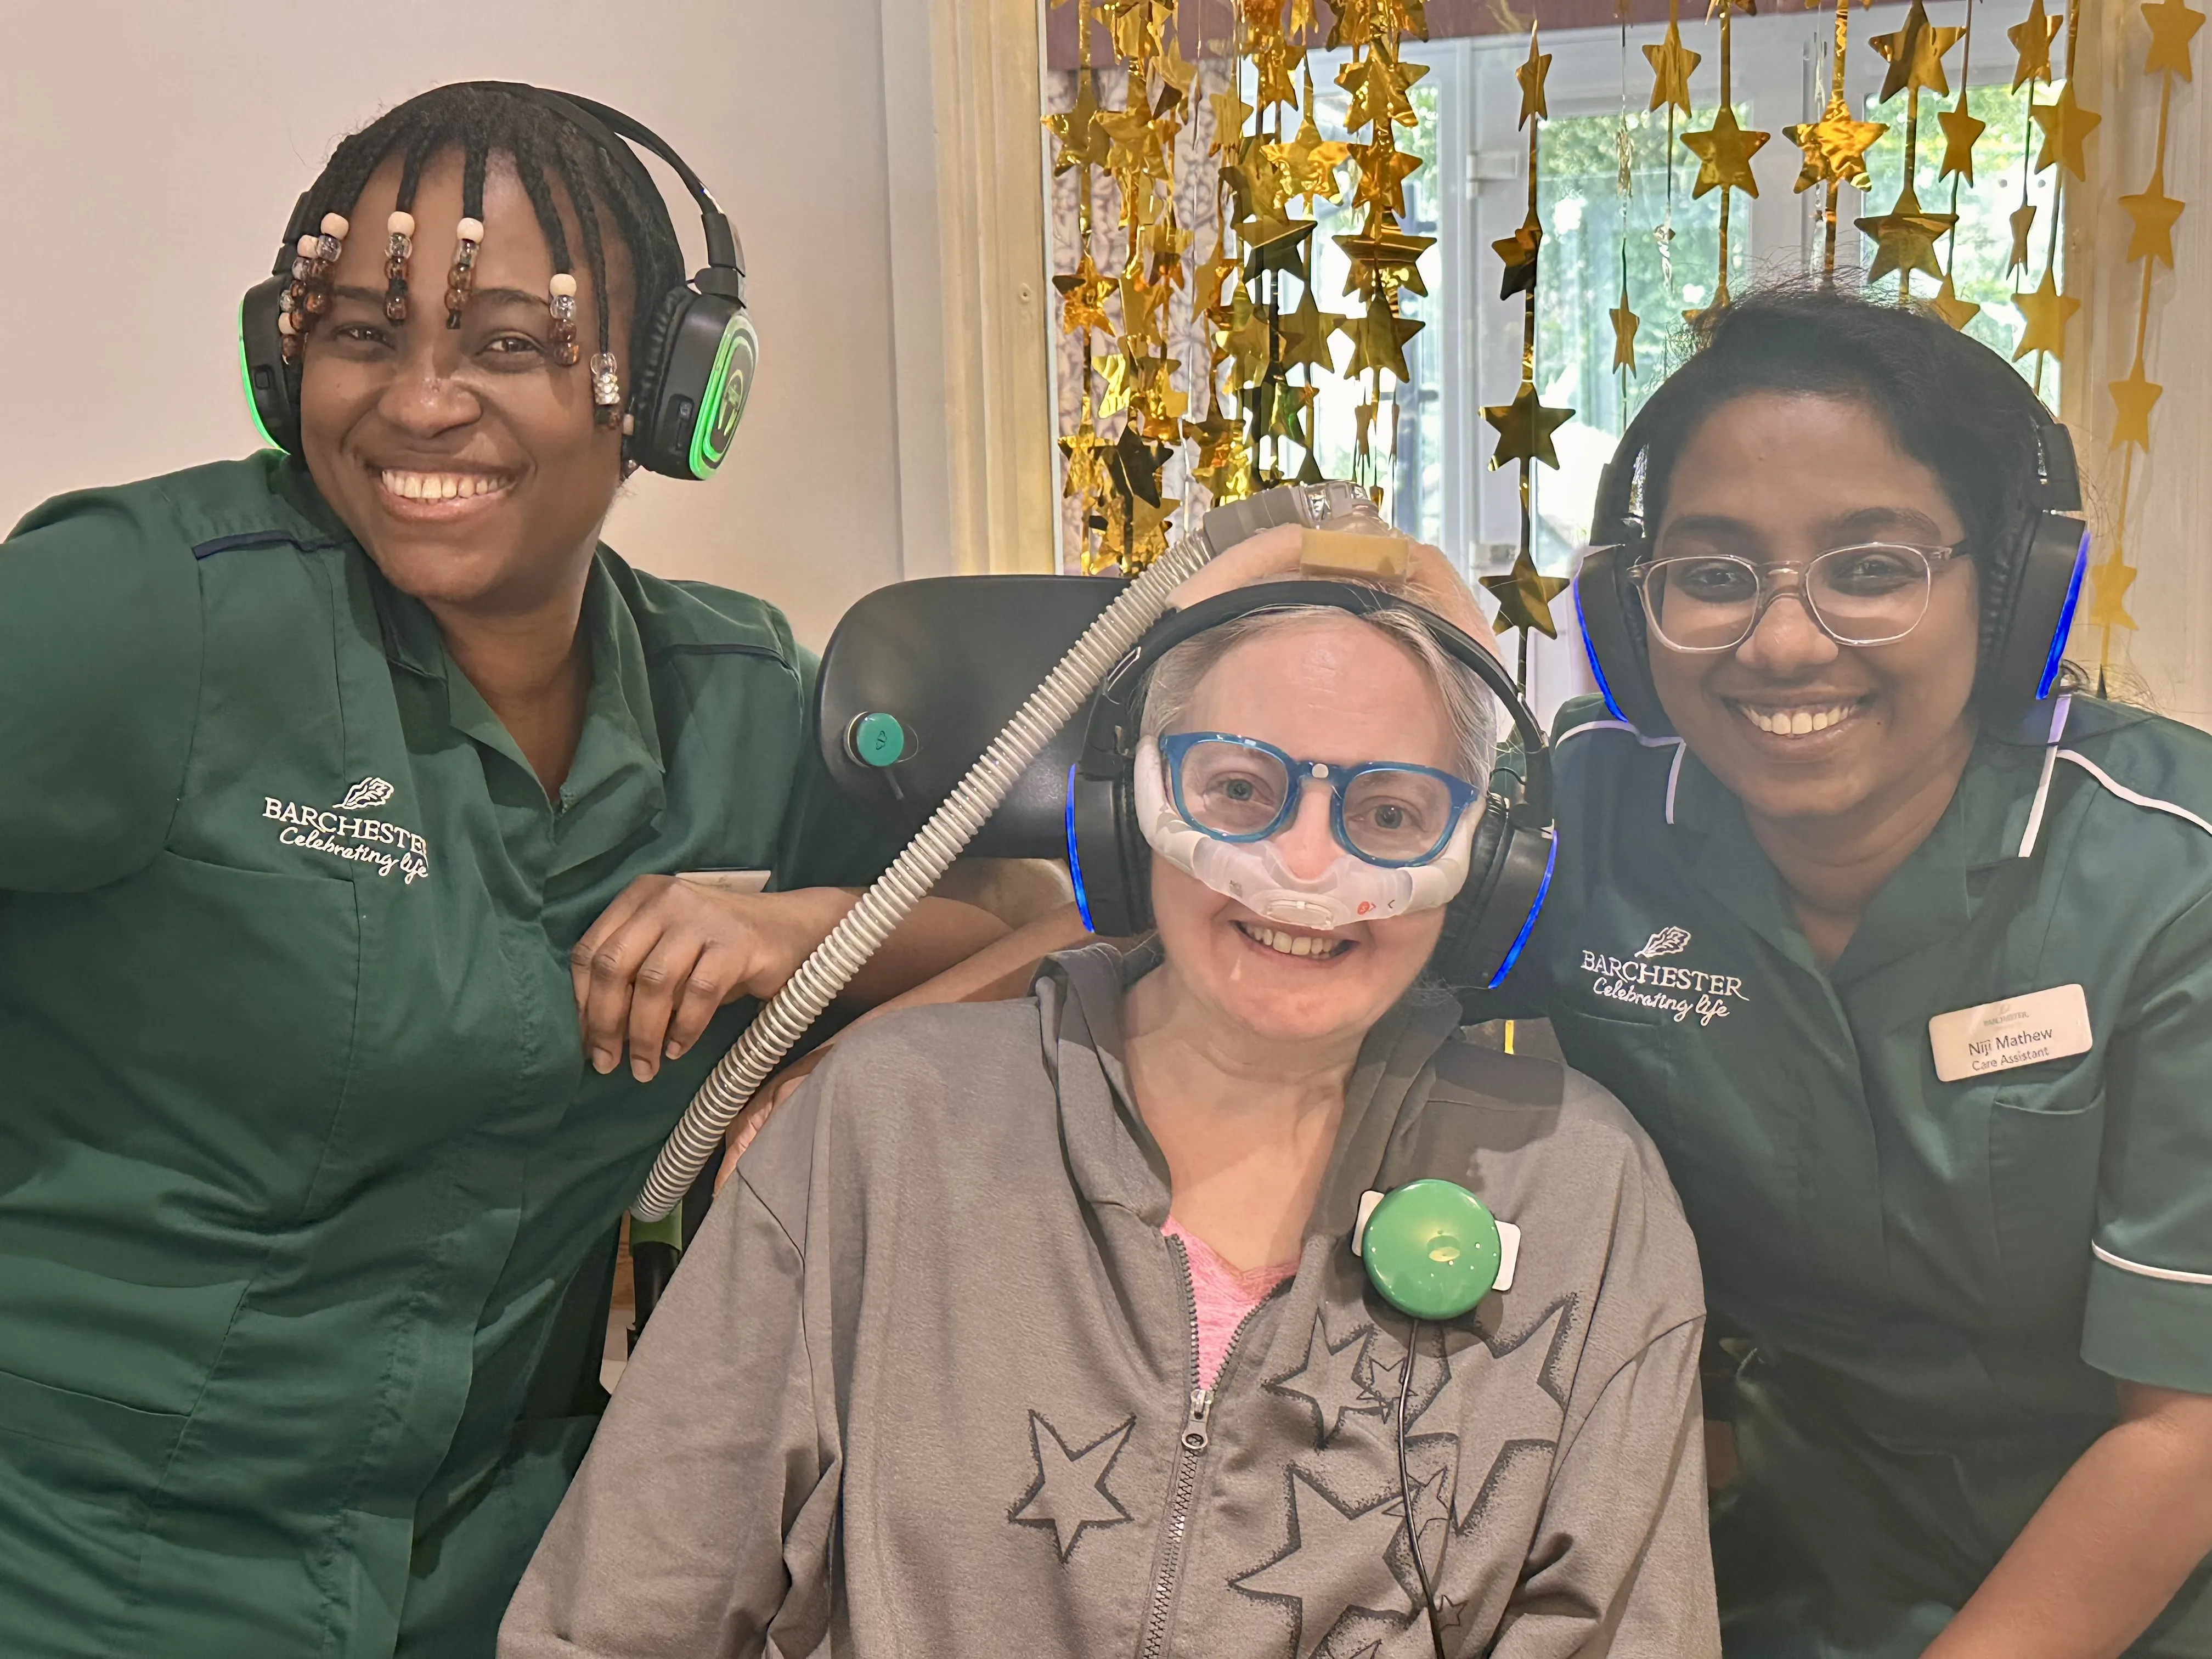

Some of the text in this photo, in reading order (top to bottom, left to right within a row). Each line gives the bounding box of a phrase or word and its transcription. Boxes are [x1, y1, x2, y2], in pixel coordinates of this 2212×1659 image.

[279, 827, 428, 884] Celebrating life
[1581, 950, 1750, 1001] BARCHESTER
[1593, 977, 1730, 1026] Celebrating life
[1968, 1029, 2052, 1056] Niji Mathew
[1972, 1047, 2050, 1071] Care Assistant
